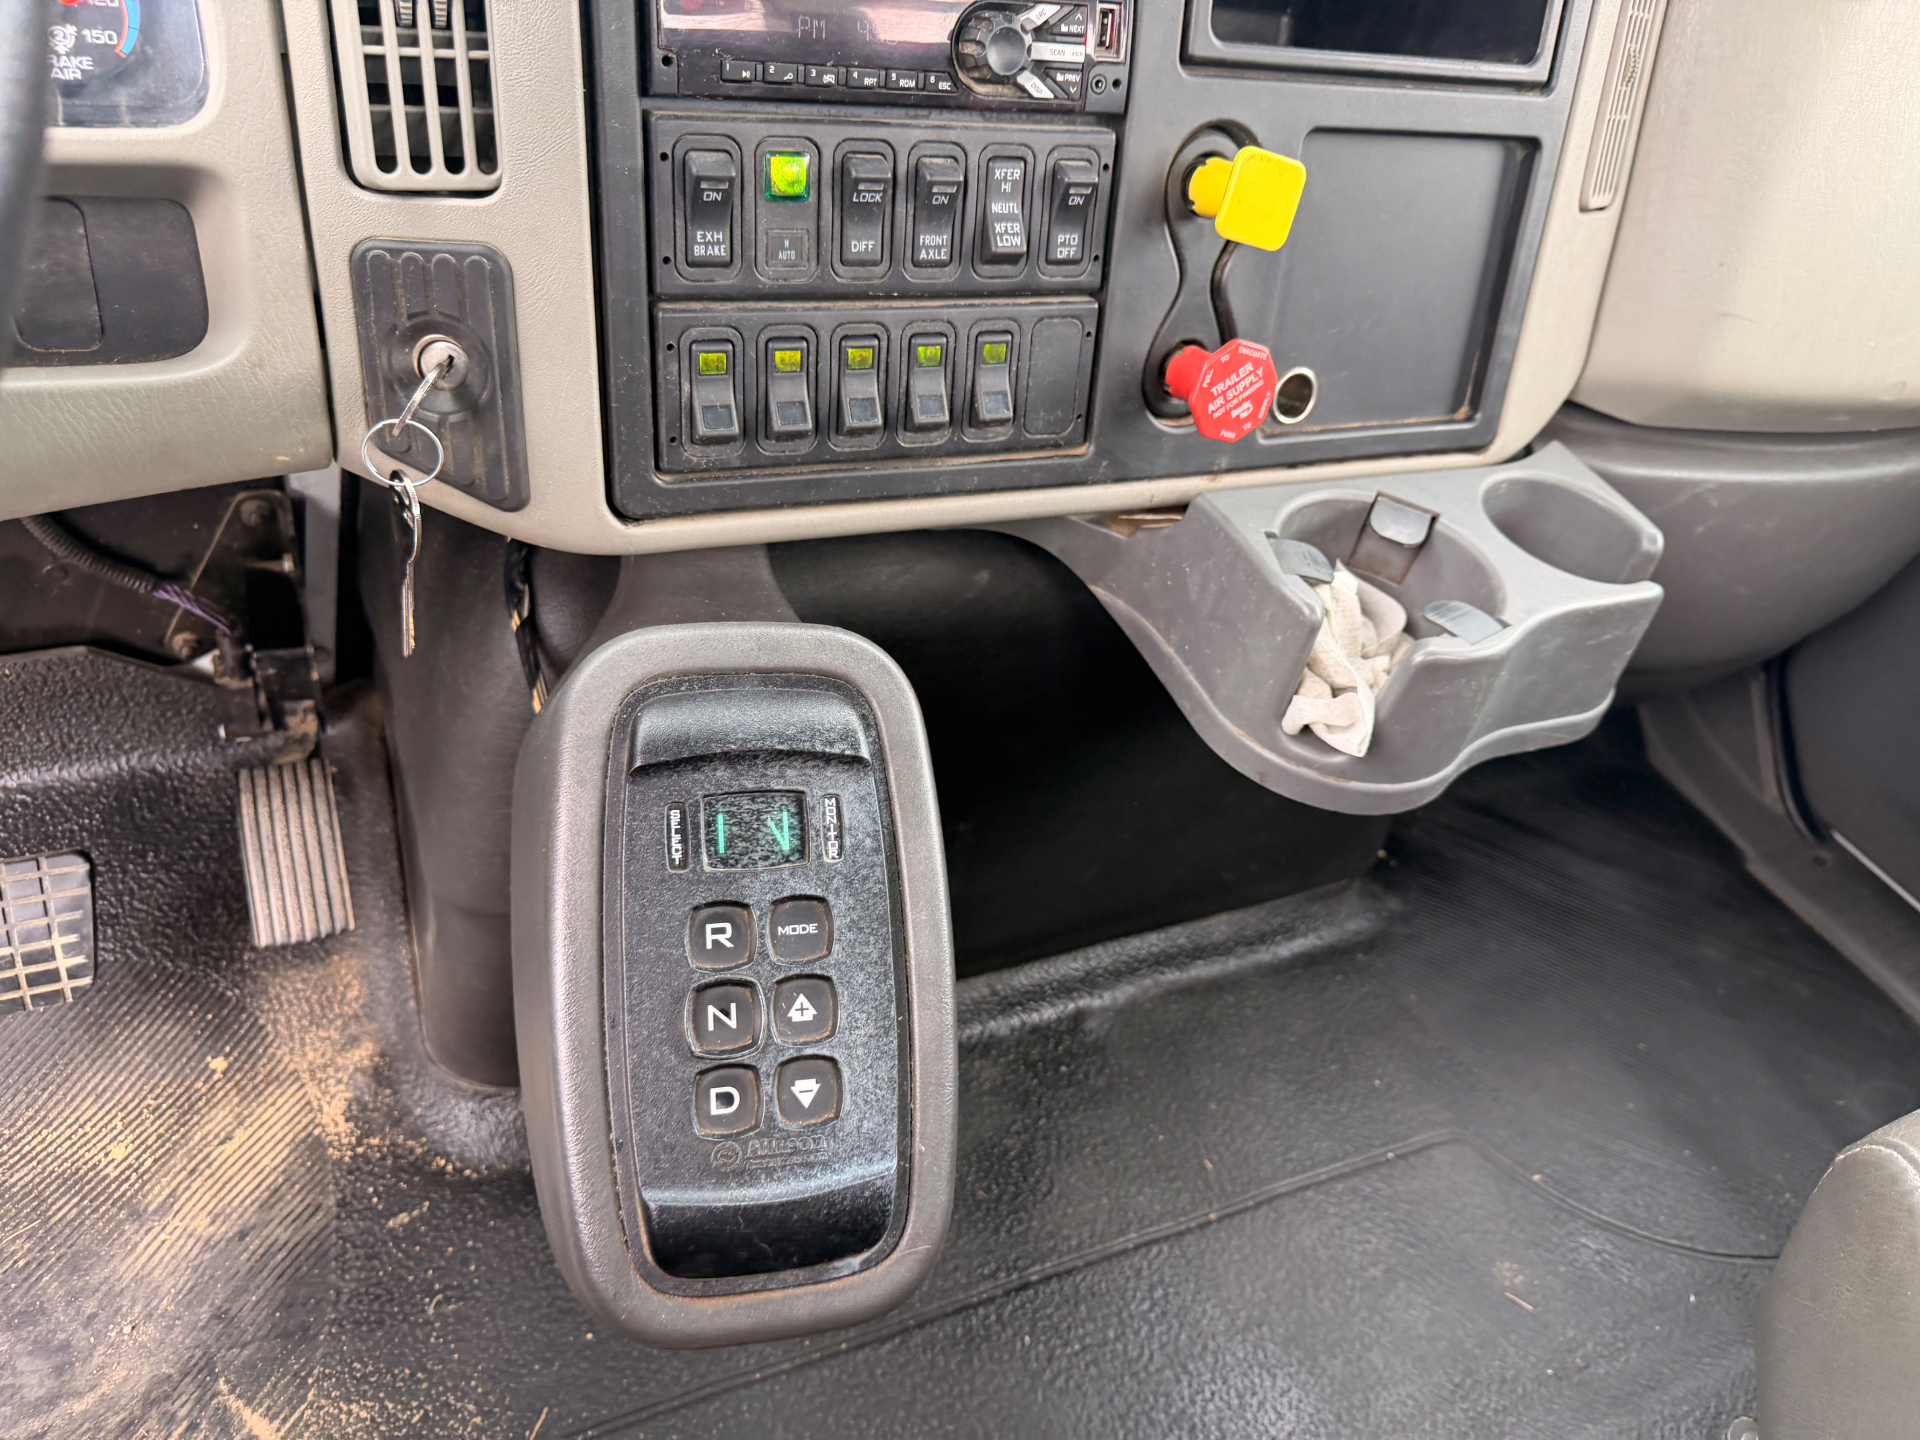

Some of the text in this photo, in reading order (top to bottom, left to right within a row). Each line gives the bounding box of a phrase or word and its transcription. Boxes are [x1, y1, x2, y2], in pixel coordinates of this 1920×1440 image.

[1035, 8, 1047, 21] SRC
[1069, 24, 1085, 34] NEXT
[81, 28, 118, 45] 150
[1049, 48, 1066, 57] SCAN
[46, 54, 95, 70] RAKE
[50, 67, 83, 80] AIR
[769, 65, 776, 74] 2
[810, 68, 817, 77] 3
[852, 71, 858, 80] 4
[863, 77, 878, 87] RPT
[1064, 73, 1081, 83] PREV
[938, 81, 952, 91] ESC
[1030, 81, 1043, 95] DISP
[994, 168, 1021, 181] XFER
[1001, 181, 1012, 193] HI
[703, 191, 723, 202] ON
[852, 192, 884, 203] LOCK
[932, 195, 950, 205] ON
[1068, 196, 1085, 206] ON
[991, 202, 1019, 214] NEUTL
[994, 222, 1021, 234] XFER
[696, 231, 723, 243] EXH
[919, 235, 948, 247] FRONT
[996, 234, 1021, 247] LOW
[1057, 234, 1078, 246] PTO
[694, 244, 727, 257] BRAKE
[851, 241, 875, 253] DIFF
[1057, 247, 1077, 259] OFF
[778, 250, 796, 260] AUTO
[919, 249, 948, 260] AXLE
[1220, 354, 1231, 364] TO
[1237, 345, 1267, 361] EVACUATE
[1210, 361, 1254, 397] TRAILER
[1208, 395, 1226, 414] AIR
[1225, 366, 1264, 401] SUPPLY
[1212, 406, 1226, 419] NOT
[1225, 396, 1239, 410] FOR
[1239, 379, 1264, 402] PARKING
[1220, 428, 1237, 439] PUSH
[1242, 421, 1253, 431] TO
[1257, 390, 1272, 419] SUPPLY
[824, 797, 839, 859] MONITOR
[670, 809, 683, 865] SELECT
[777, 923, 819, 936] MODE
[705, 922, 735, 950] R
[707, 1002, 738, 1032] N
[709, 1086, 741, 1116] D
